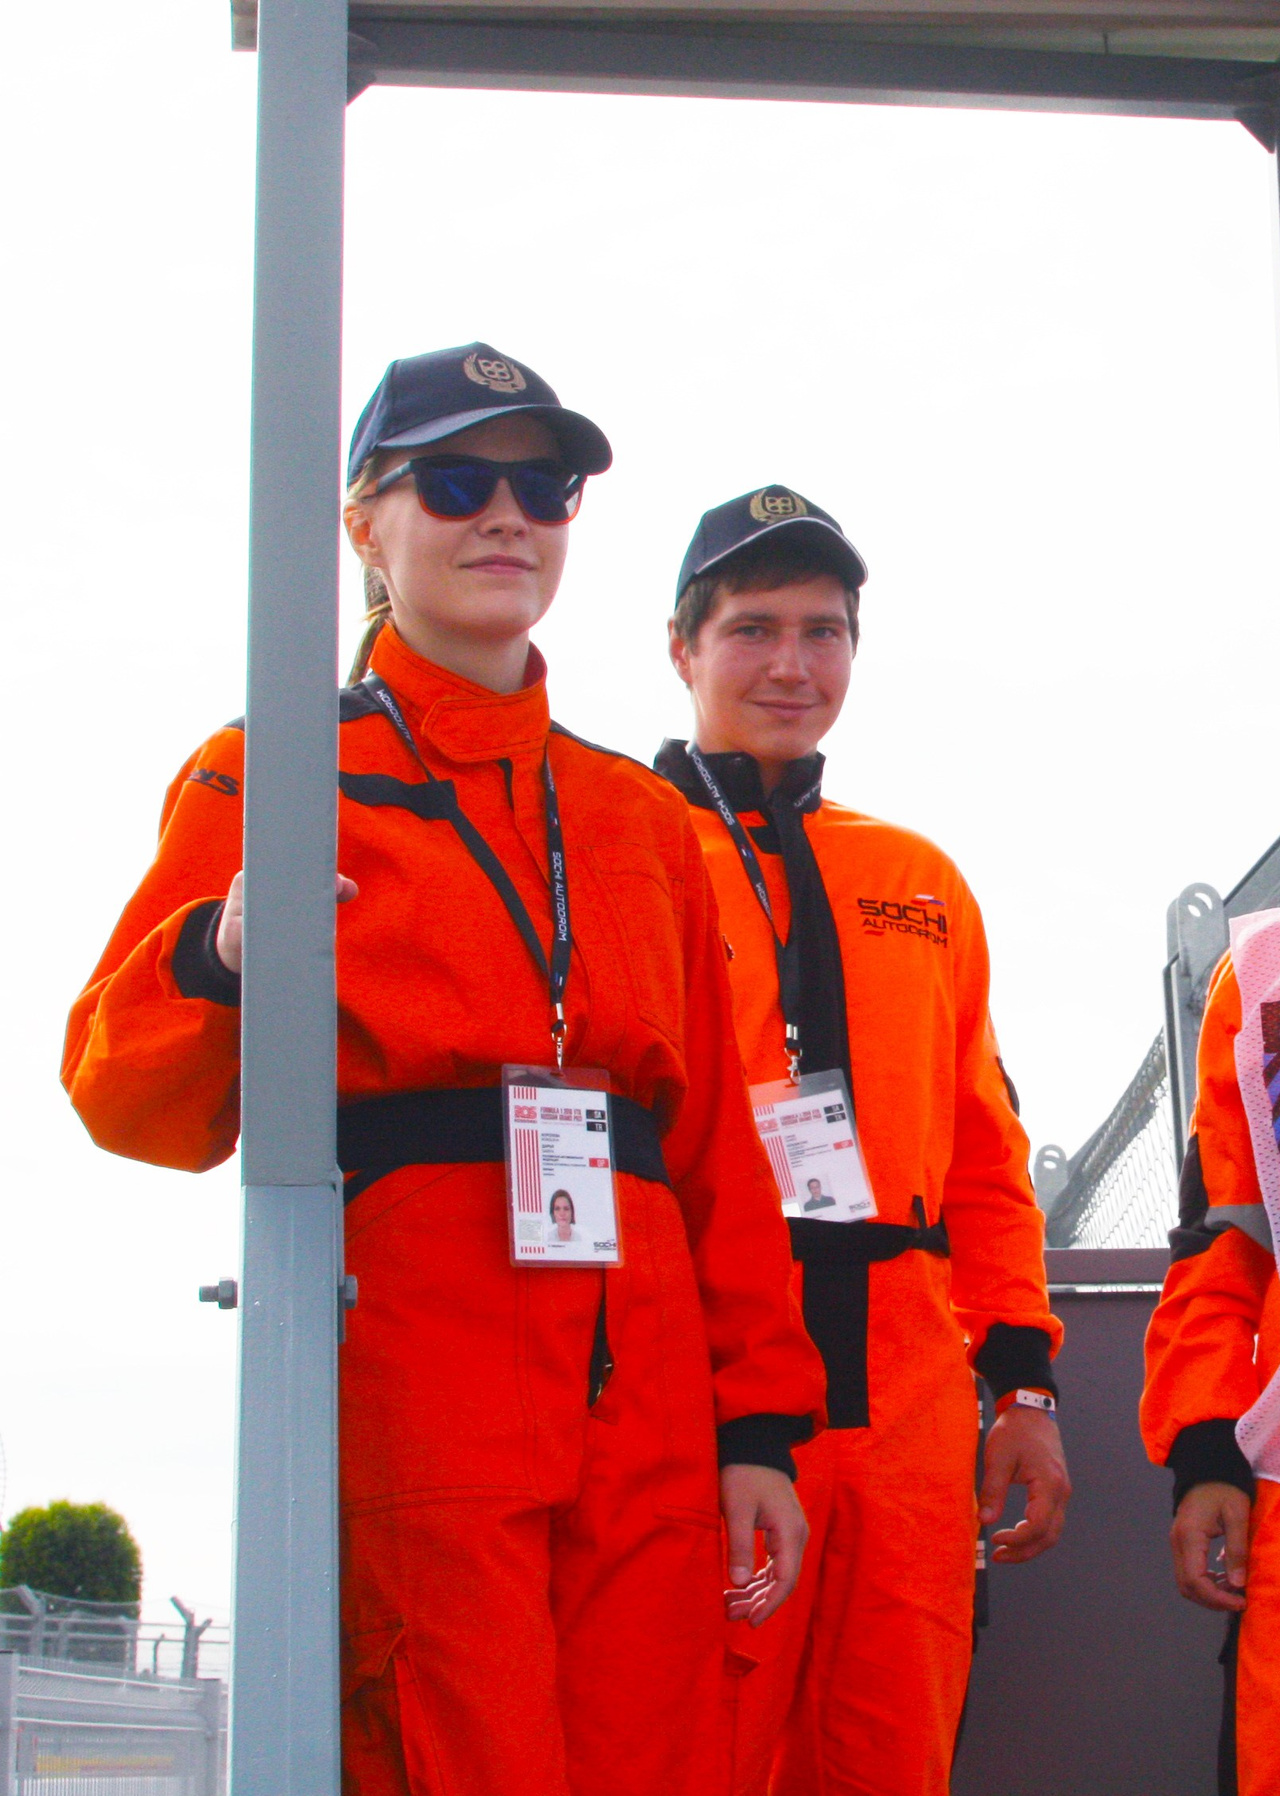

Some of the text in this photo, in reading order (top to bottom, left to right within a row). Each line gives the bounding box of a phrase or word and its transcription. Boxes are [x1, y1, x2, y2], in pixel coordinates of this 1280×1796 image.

[555, 881, 567, 942] AUTODROM
[857, 898, 947, 934] SOCHI
[863, 917, 948, 948] AUTODROM
